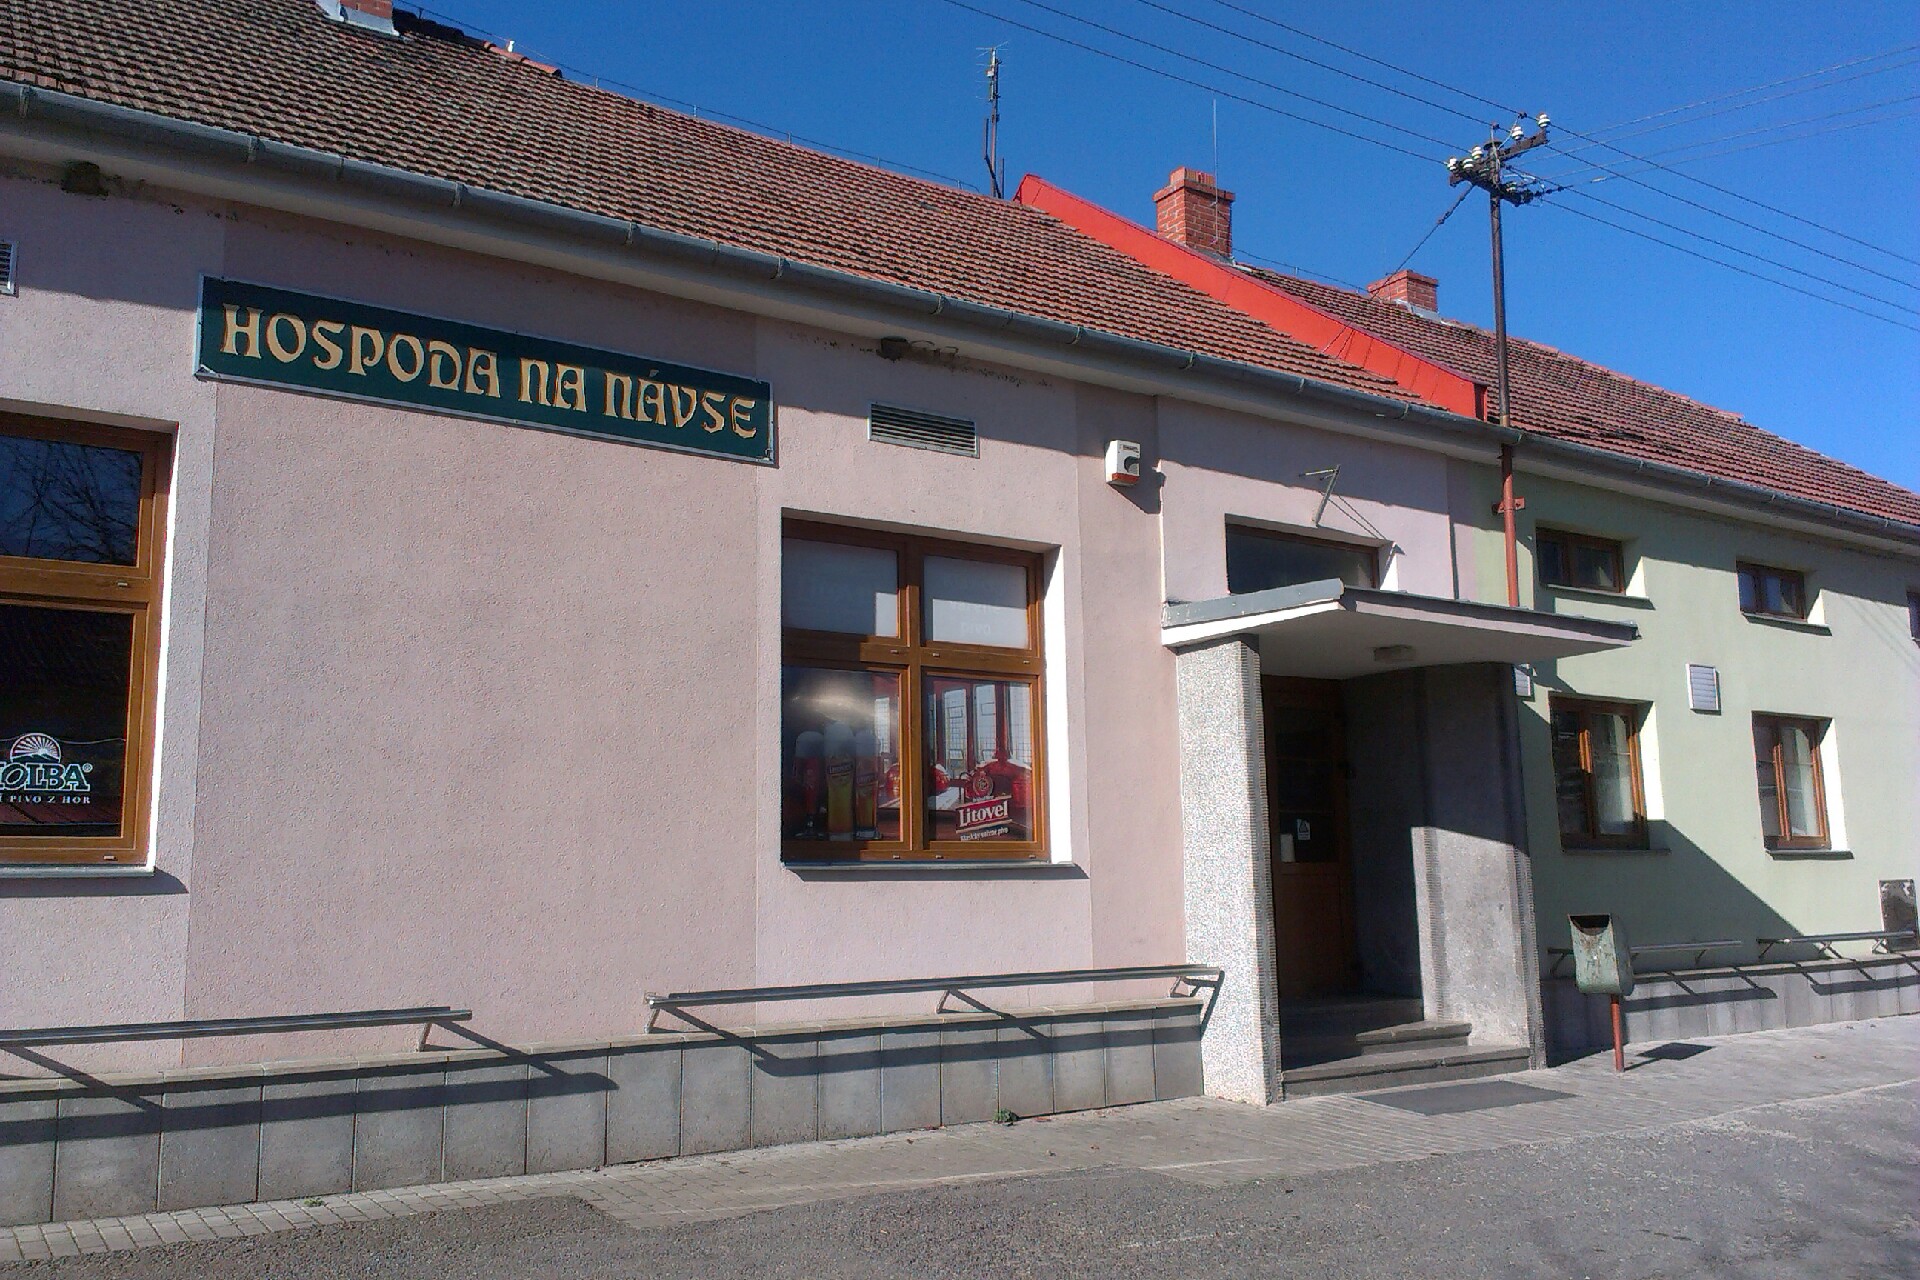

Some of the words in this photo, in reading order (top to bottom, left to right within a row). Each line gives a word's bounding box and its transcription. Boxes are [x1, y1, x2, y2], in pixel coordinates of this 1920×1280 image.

[220, 303, 501, 398] HOSPODA
[518, 357, 588, 412] NA
[603, 369, 757, 438] NÁVSE
[0, 761, 91, 792] OLBA
[9, 795, 42, 803] PIVO
[62, 795, 91, 804] HOR
[958, 800, 1009, 828] Litovel
